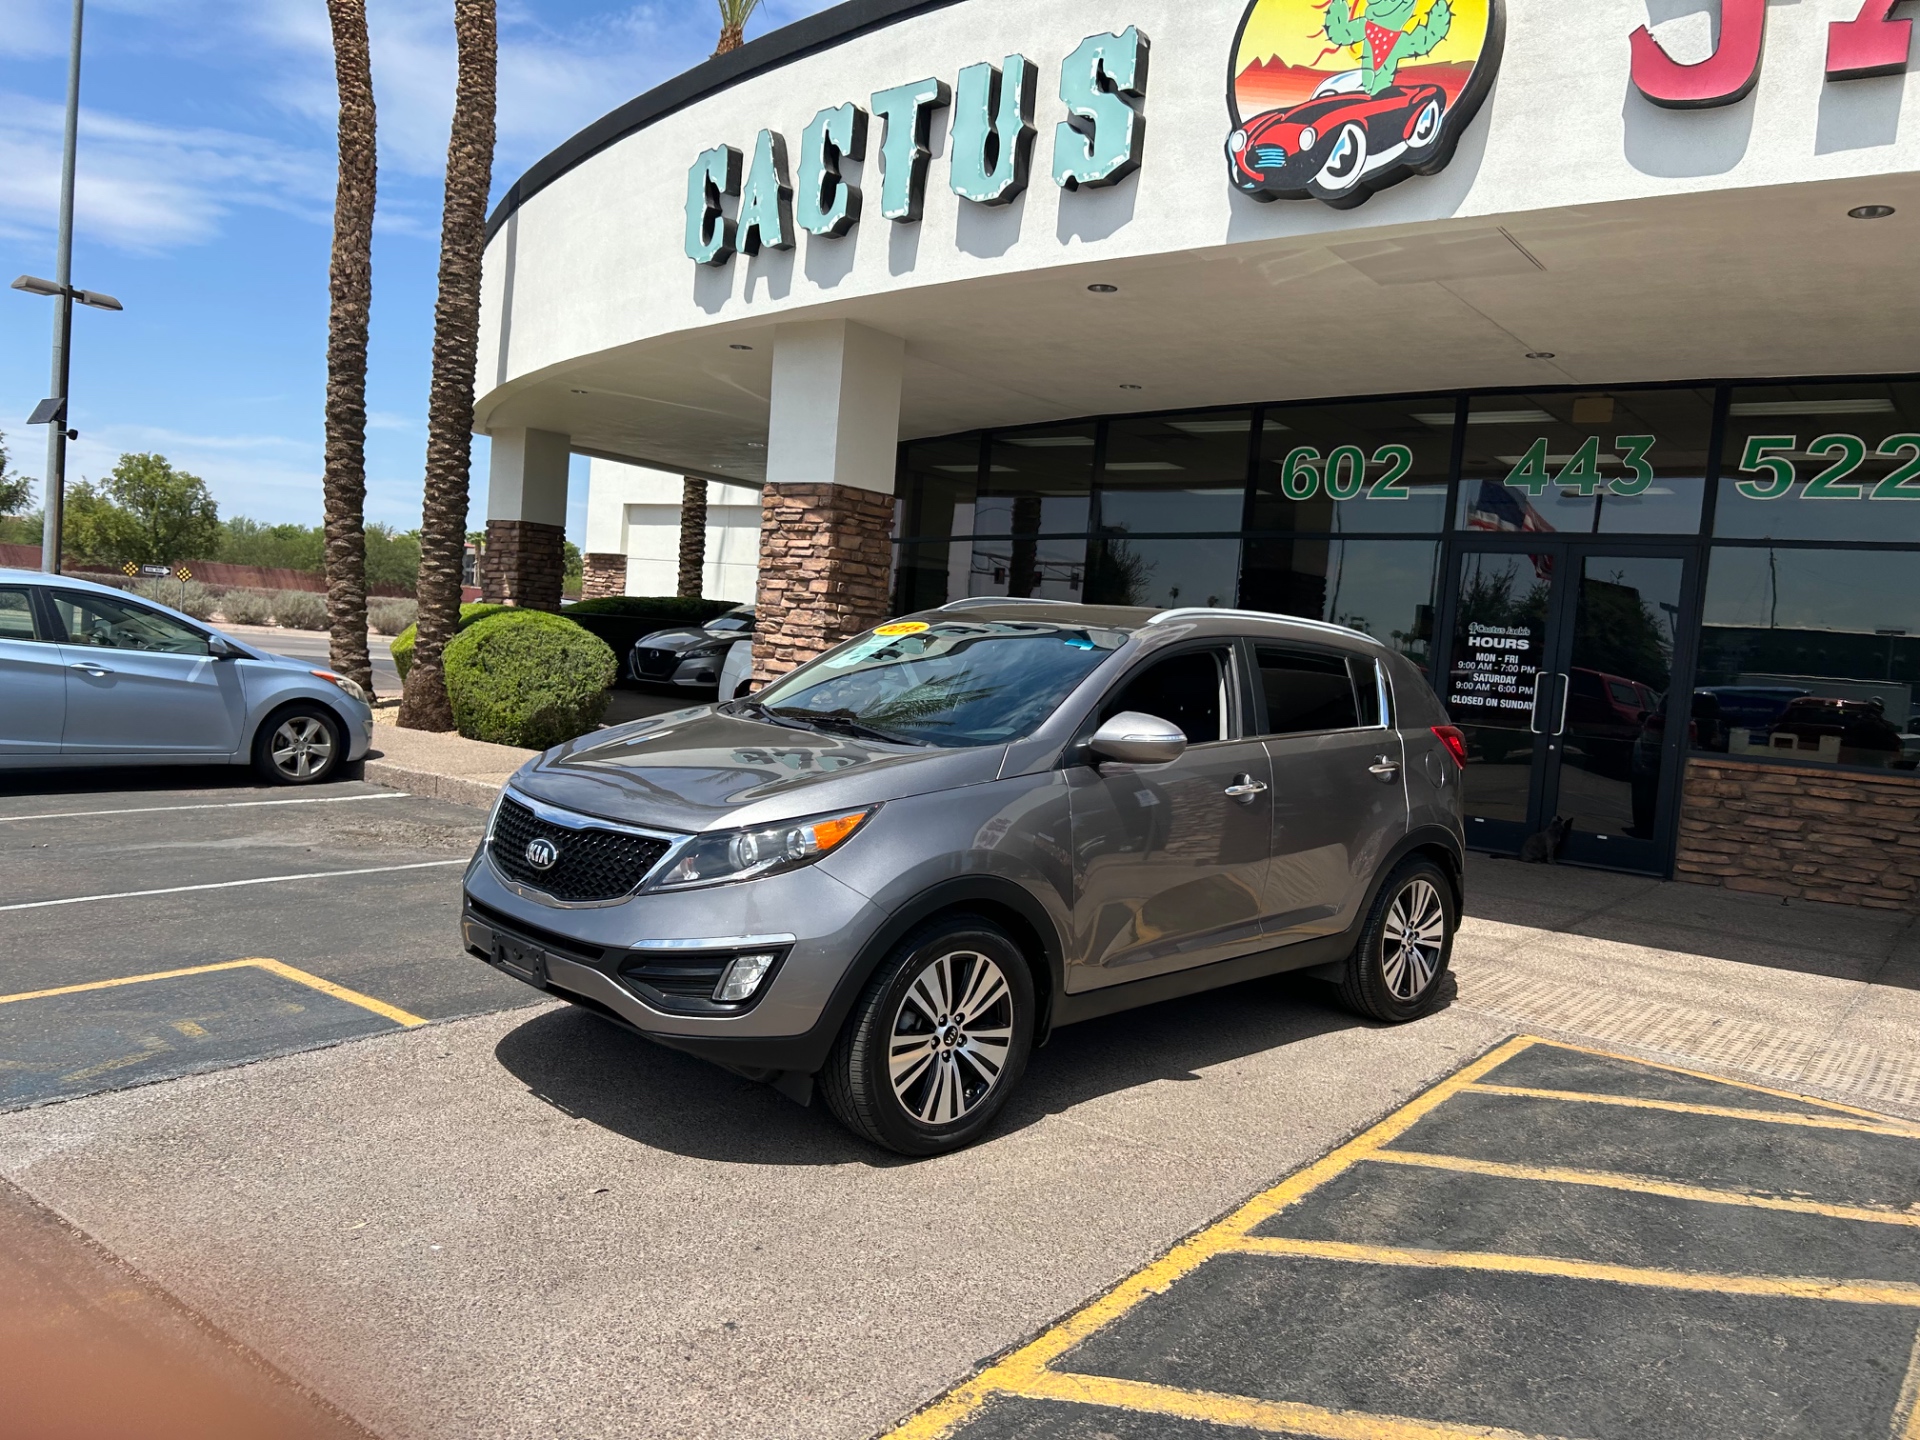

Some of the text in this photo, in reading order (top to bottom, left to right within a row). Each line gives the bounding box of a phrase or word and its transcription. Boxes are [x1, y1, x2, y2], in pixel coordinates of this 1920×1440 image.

[684, 24, 1151, 267] CACTUS
[1281, 432, 1920, 502] 602 443 522
[1468, 636, 1530, 650] HOURS
[1475, 652, 1496, 663] MON
[1504, 654, 1519, 664] FRI
[1457, 660, 1476, 670] 9:00
[1477, 662, 1492, 671] AM
[1500, 663, 1519, 673] 7:00
[1520, 665, 1536, 674] PM
[1472, 672, 1517, 684] SATURDAY
[1455, 681, 1474, 690] 9:00
[1474, 682, 1490, 691] AM
[1497, 684, 1517, 693] 6:00
[1518, 686, 1534, 695] PM
[1451, 695, 1534, 710] CLOSED ON SUNDAY
[528, 843, 549, 865] KIA
